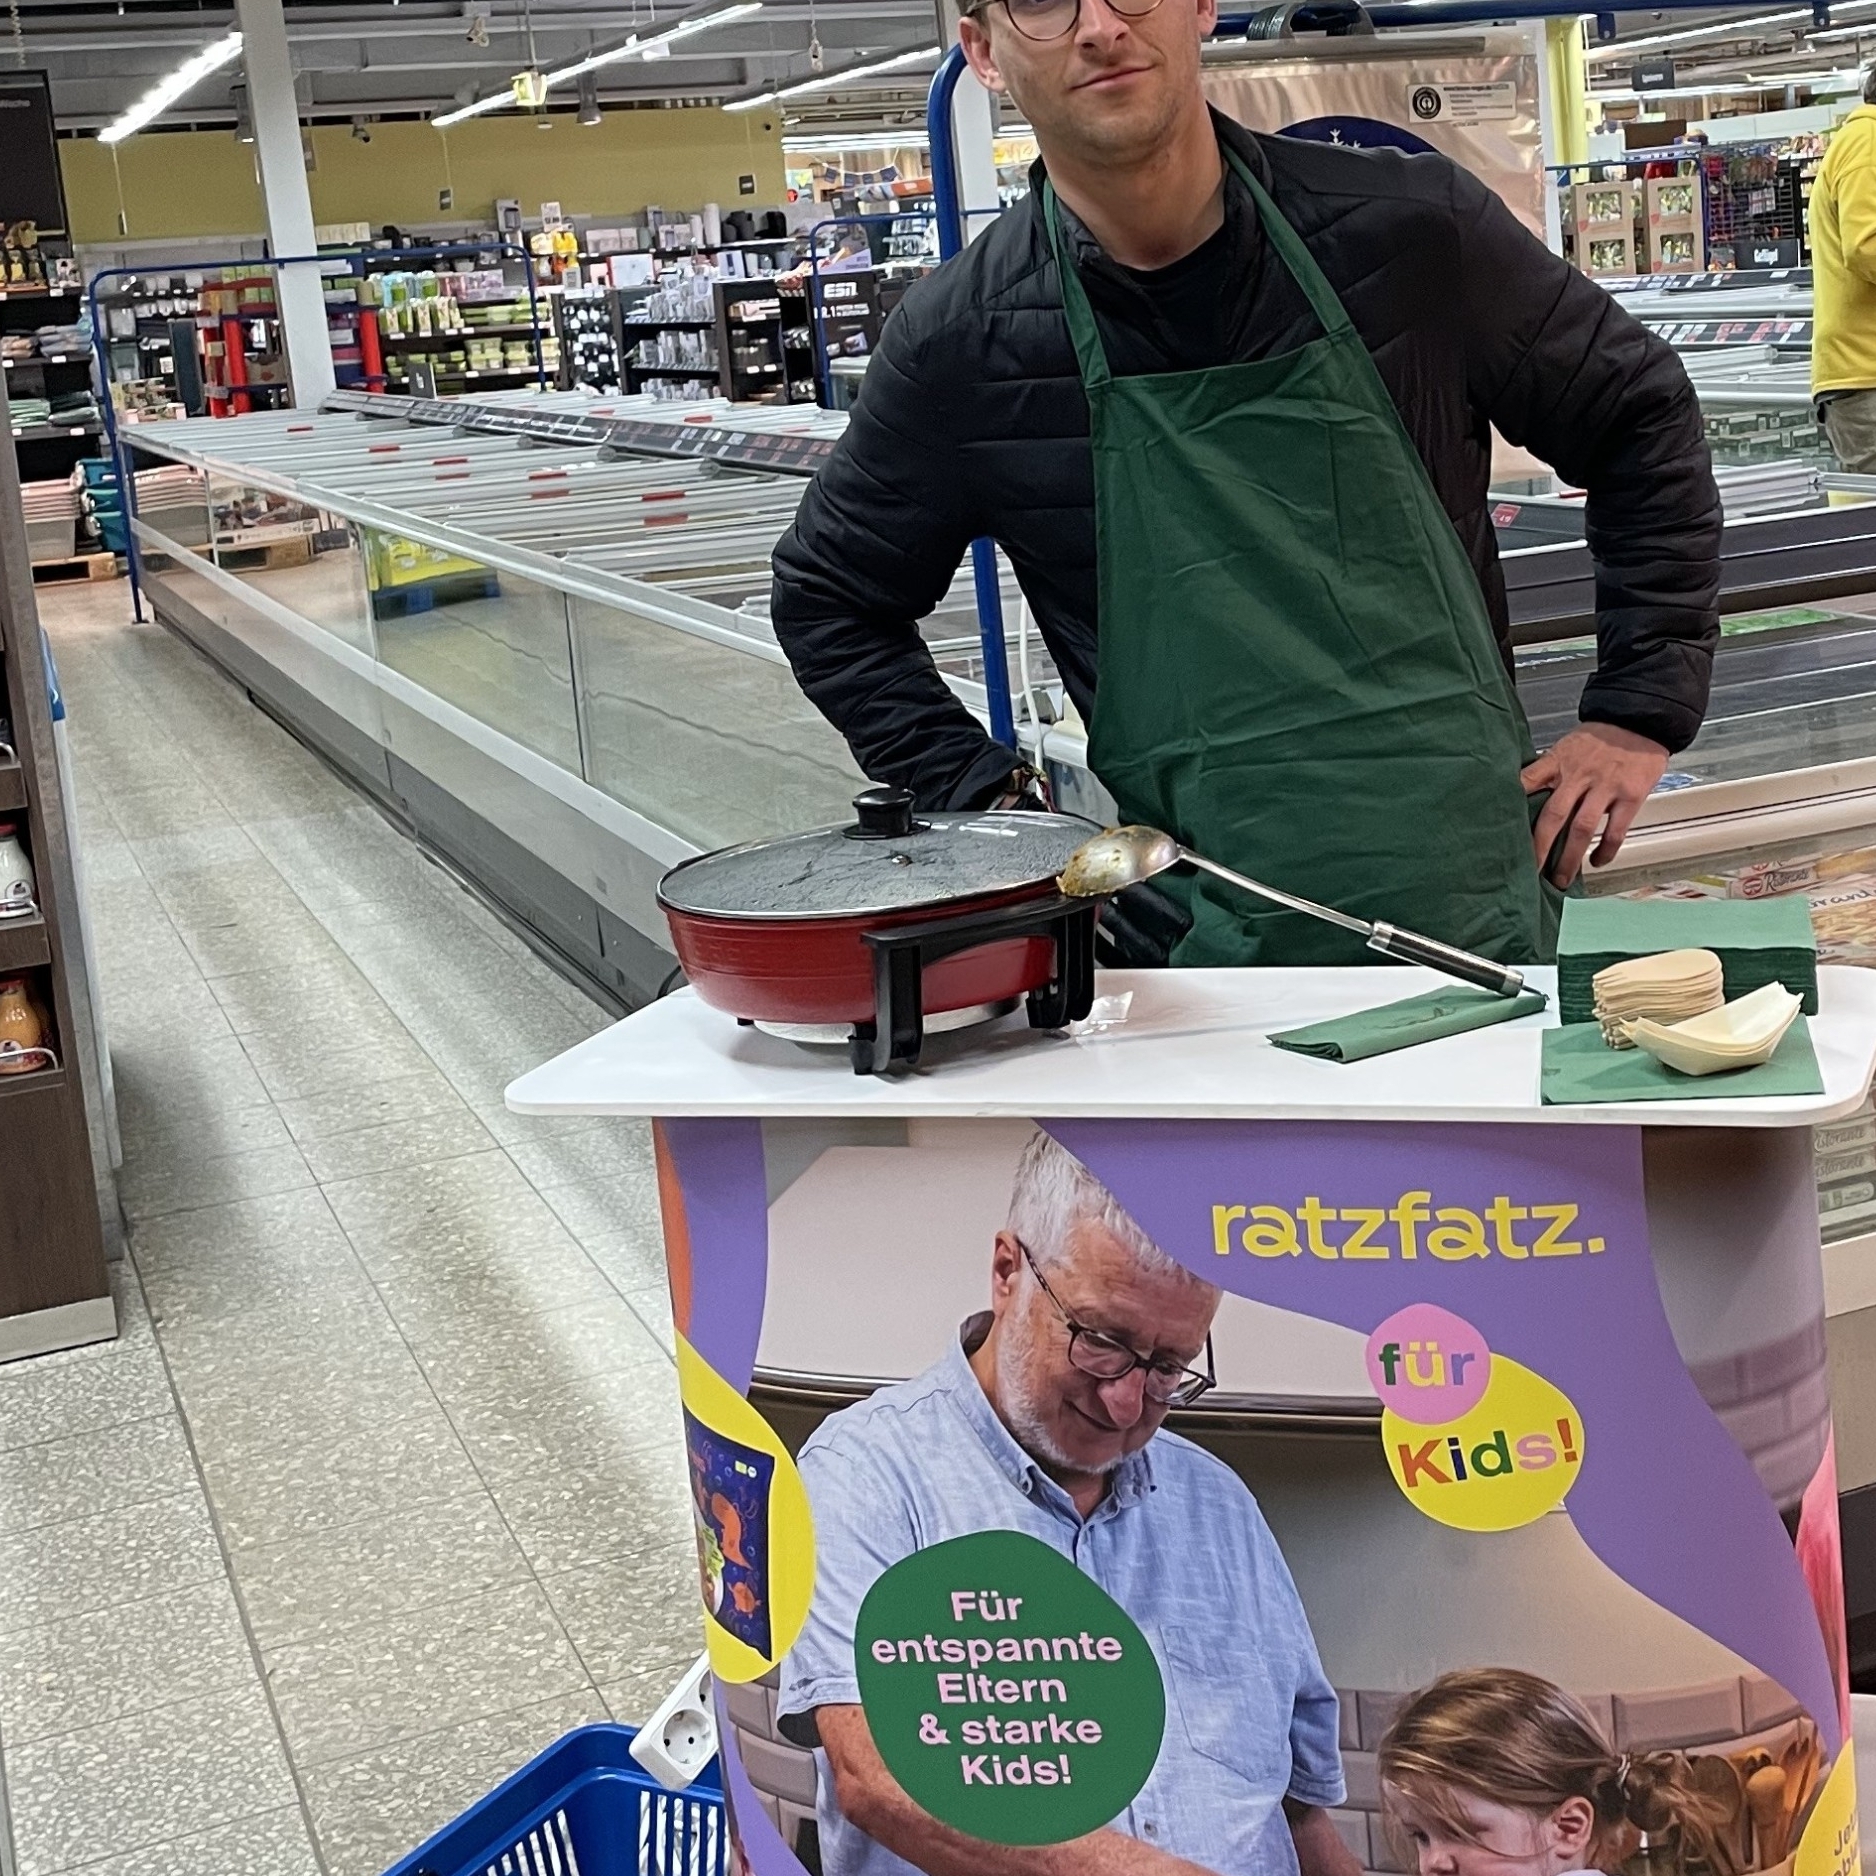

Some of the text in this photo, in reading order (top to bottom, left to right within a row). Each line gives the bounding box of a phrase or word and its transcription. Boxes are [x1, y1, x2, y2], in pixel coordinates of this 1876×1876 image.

[1212, 1190, 1606, 1260] ratzfatz.
[1378, 1341, 1476, 1387] für
[1398, 1418, 1578, 1488] Kids!
[950, 1590, 1023, 1622] Für
[871, 1631, 1123, 1668] entspannte
[937, 1673, 1067, 1705] Eltern
[918, 1712, 1103, 1745] & starke
[960, 1754, 1072, 1786] Kids!
